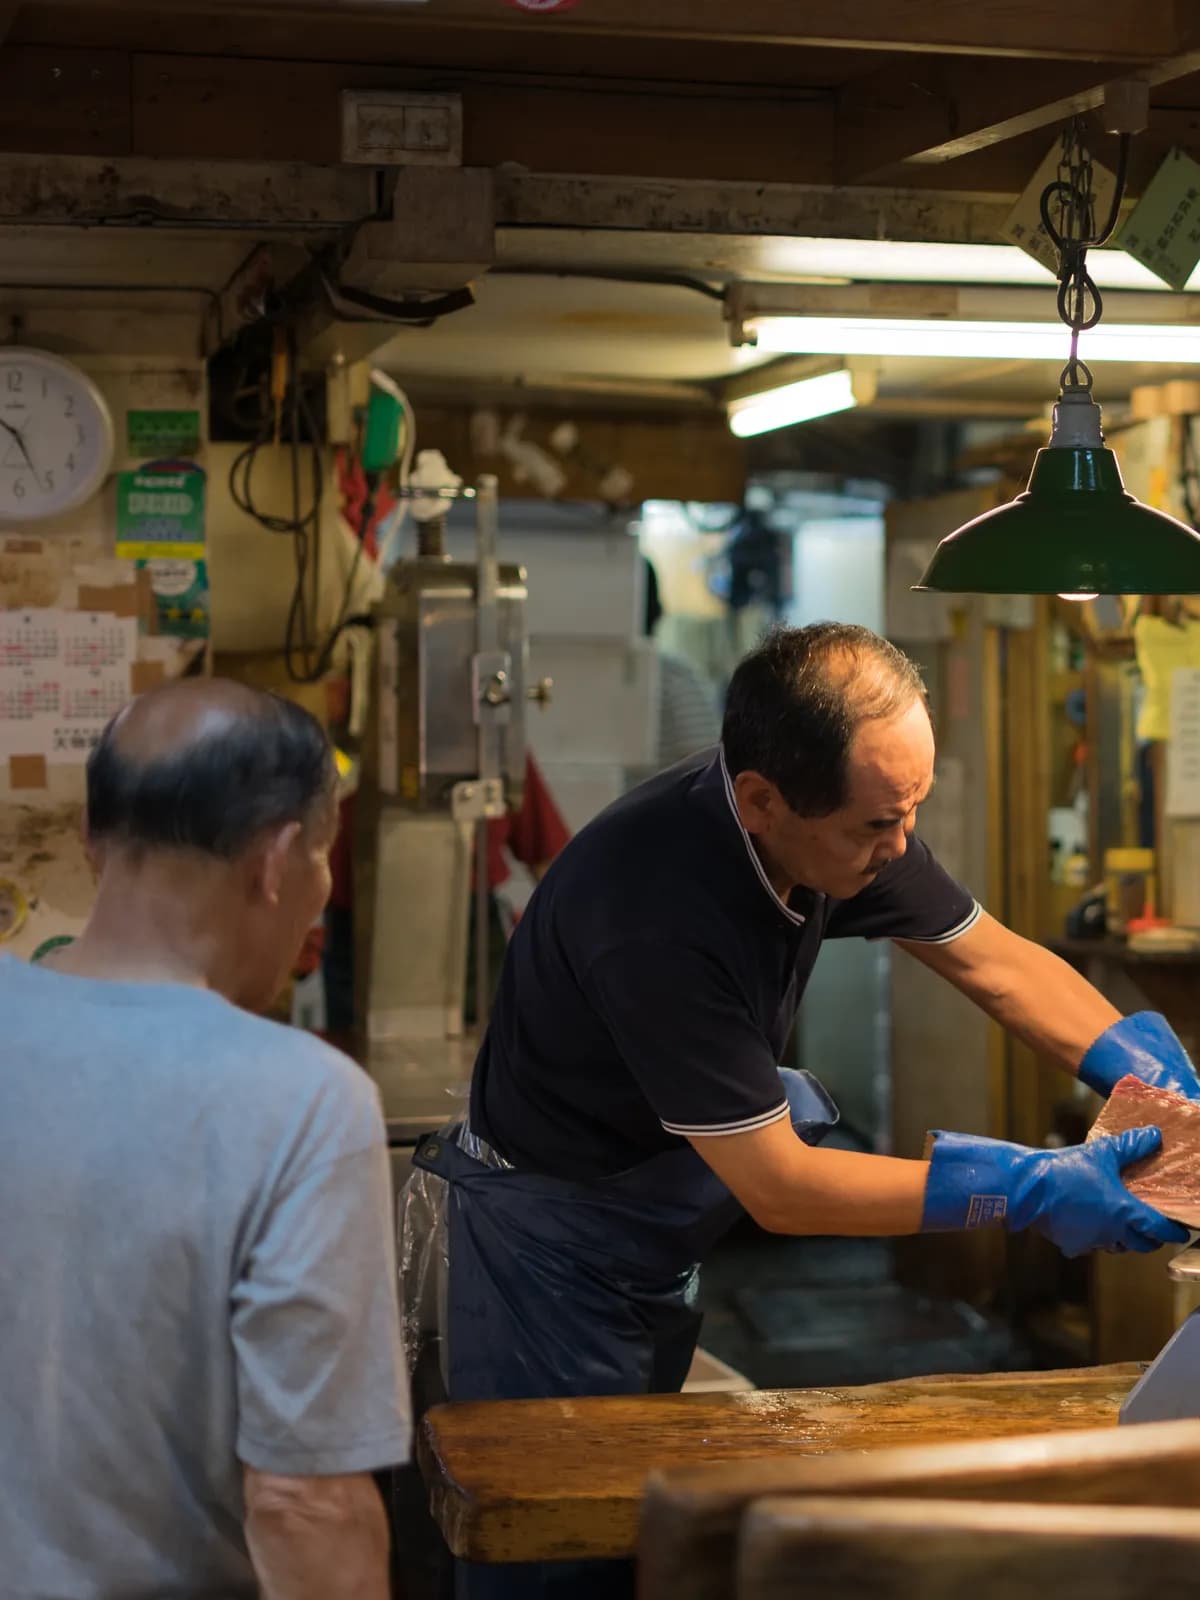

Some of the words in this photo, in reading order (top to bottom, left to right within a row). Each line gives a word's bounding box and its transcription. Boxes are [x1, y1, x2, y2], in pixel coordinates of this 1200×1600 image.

[7, 370, 23, 393] 12
[64, 393, 75, 418] 2
[64, 453, 75, 473] 4
[13, 478, 25, 498] 6
[41, 470, 54, 492] 5
